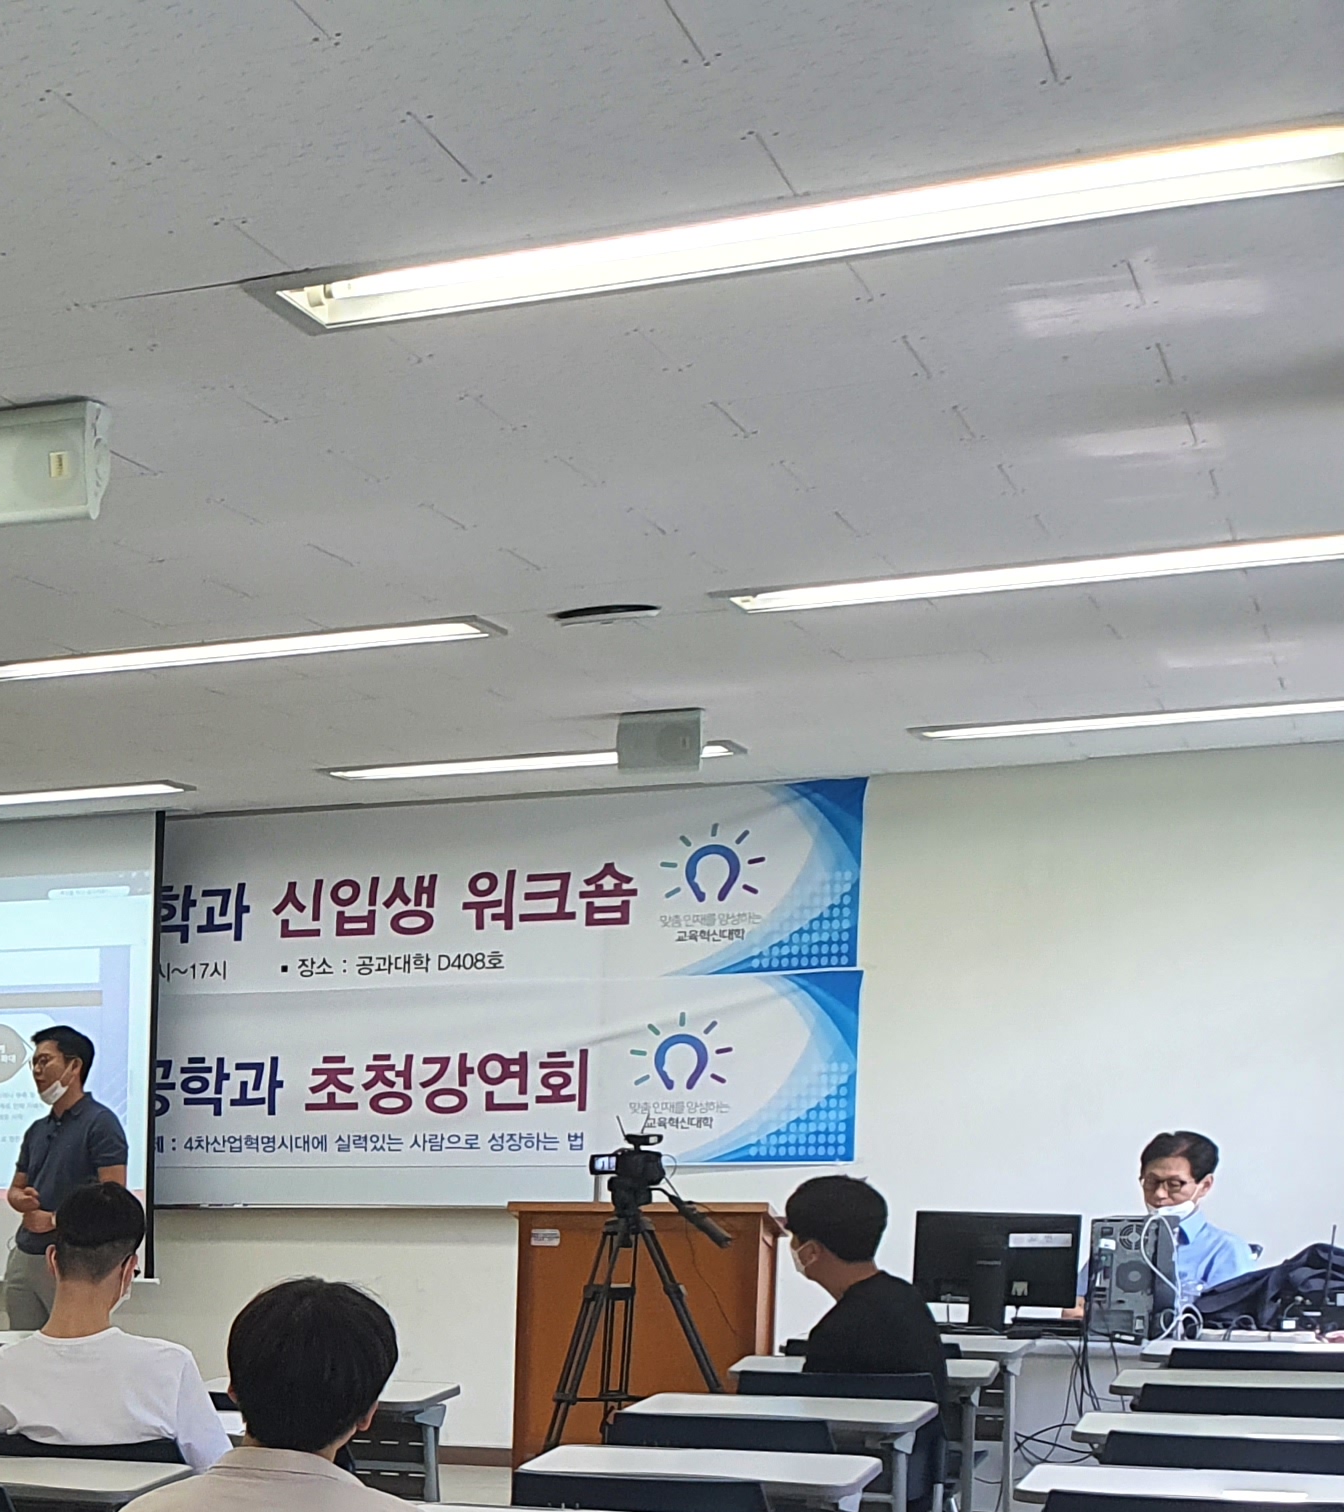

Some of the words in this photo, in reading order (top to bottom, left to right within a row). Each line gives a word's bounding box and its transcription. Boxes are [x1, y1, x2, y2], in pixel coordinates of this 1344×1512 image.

[159, 882, 250, 944] 학과
[272, 873, 438, 938] 신입생
[462, 862, 638, 931] 워크숍
[675, 928, 745, 942] 교육혁신대학
[297, 957, 334, 978] 장소
[356, 953, 430, 976] 공과대학
[437, 951, 505, 972] D408호
[155, 1056, 284, 1118] 공학과
[304, 1048, 590, 1116] 초청강연회
[644, 1116, 714, 1129] 교육혁신대학
[184, 1133, 328, 1154] 4차산업혁명시대에
[334, 1133, 404, 1151] 실력있는
[409, 1133, 481, 1151] 사람으로
[487, 1132, 559, 1151] 성장하는
[567, 1132, 584, 1151] 법
